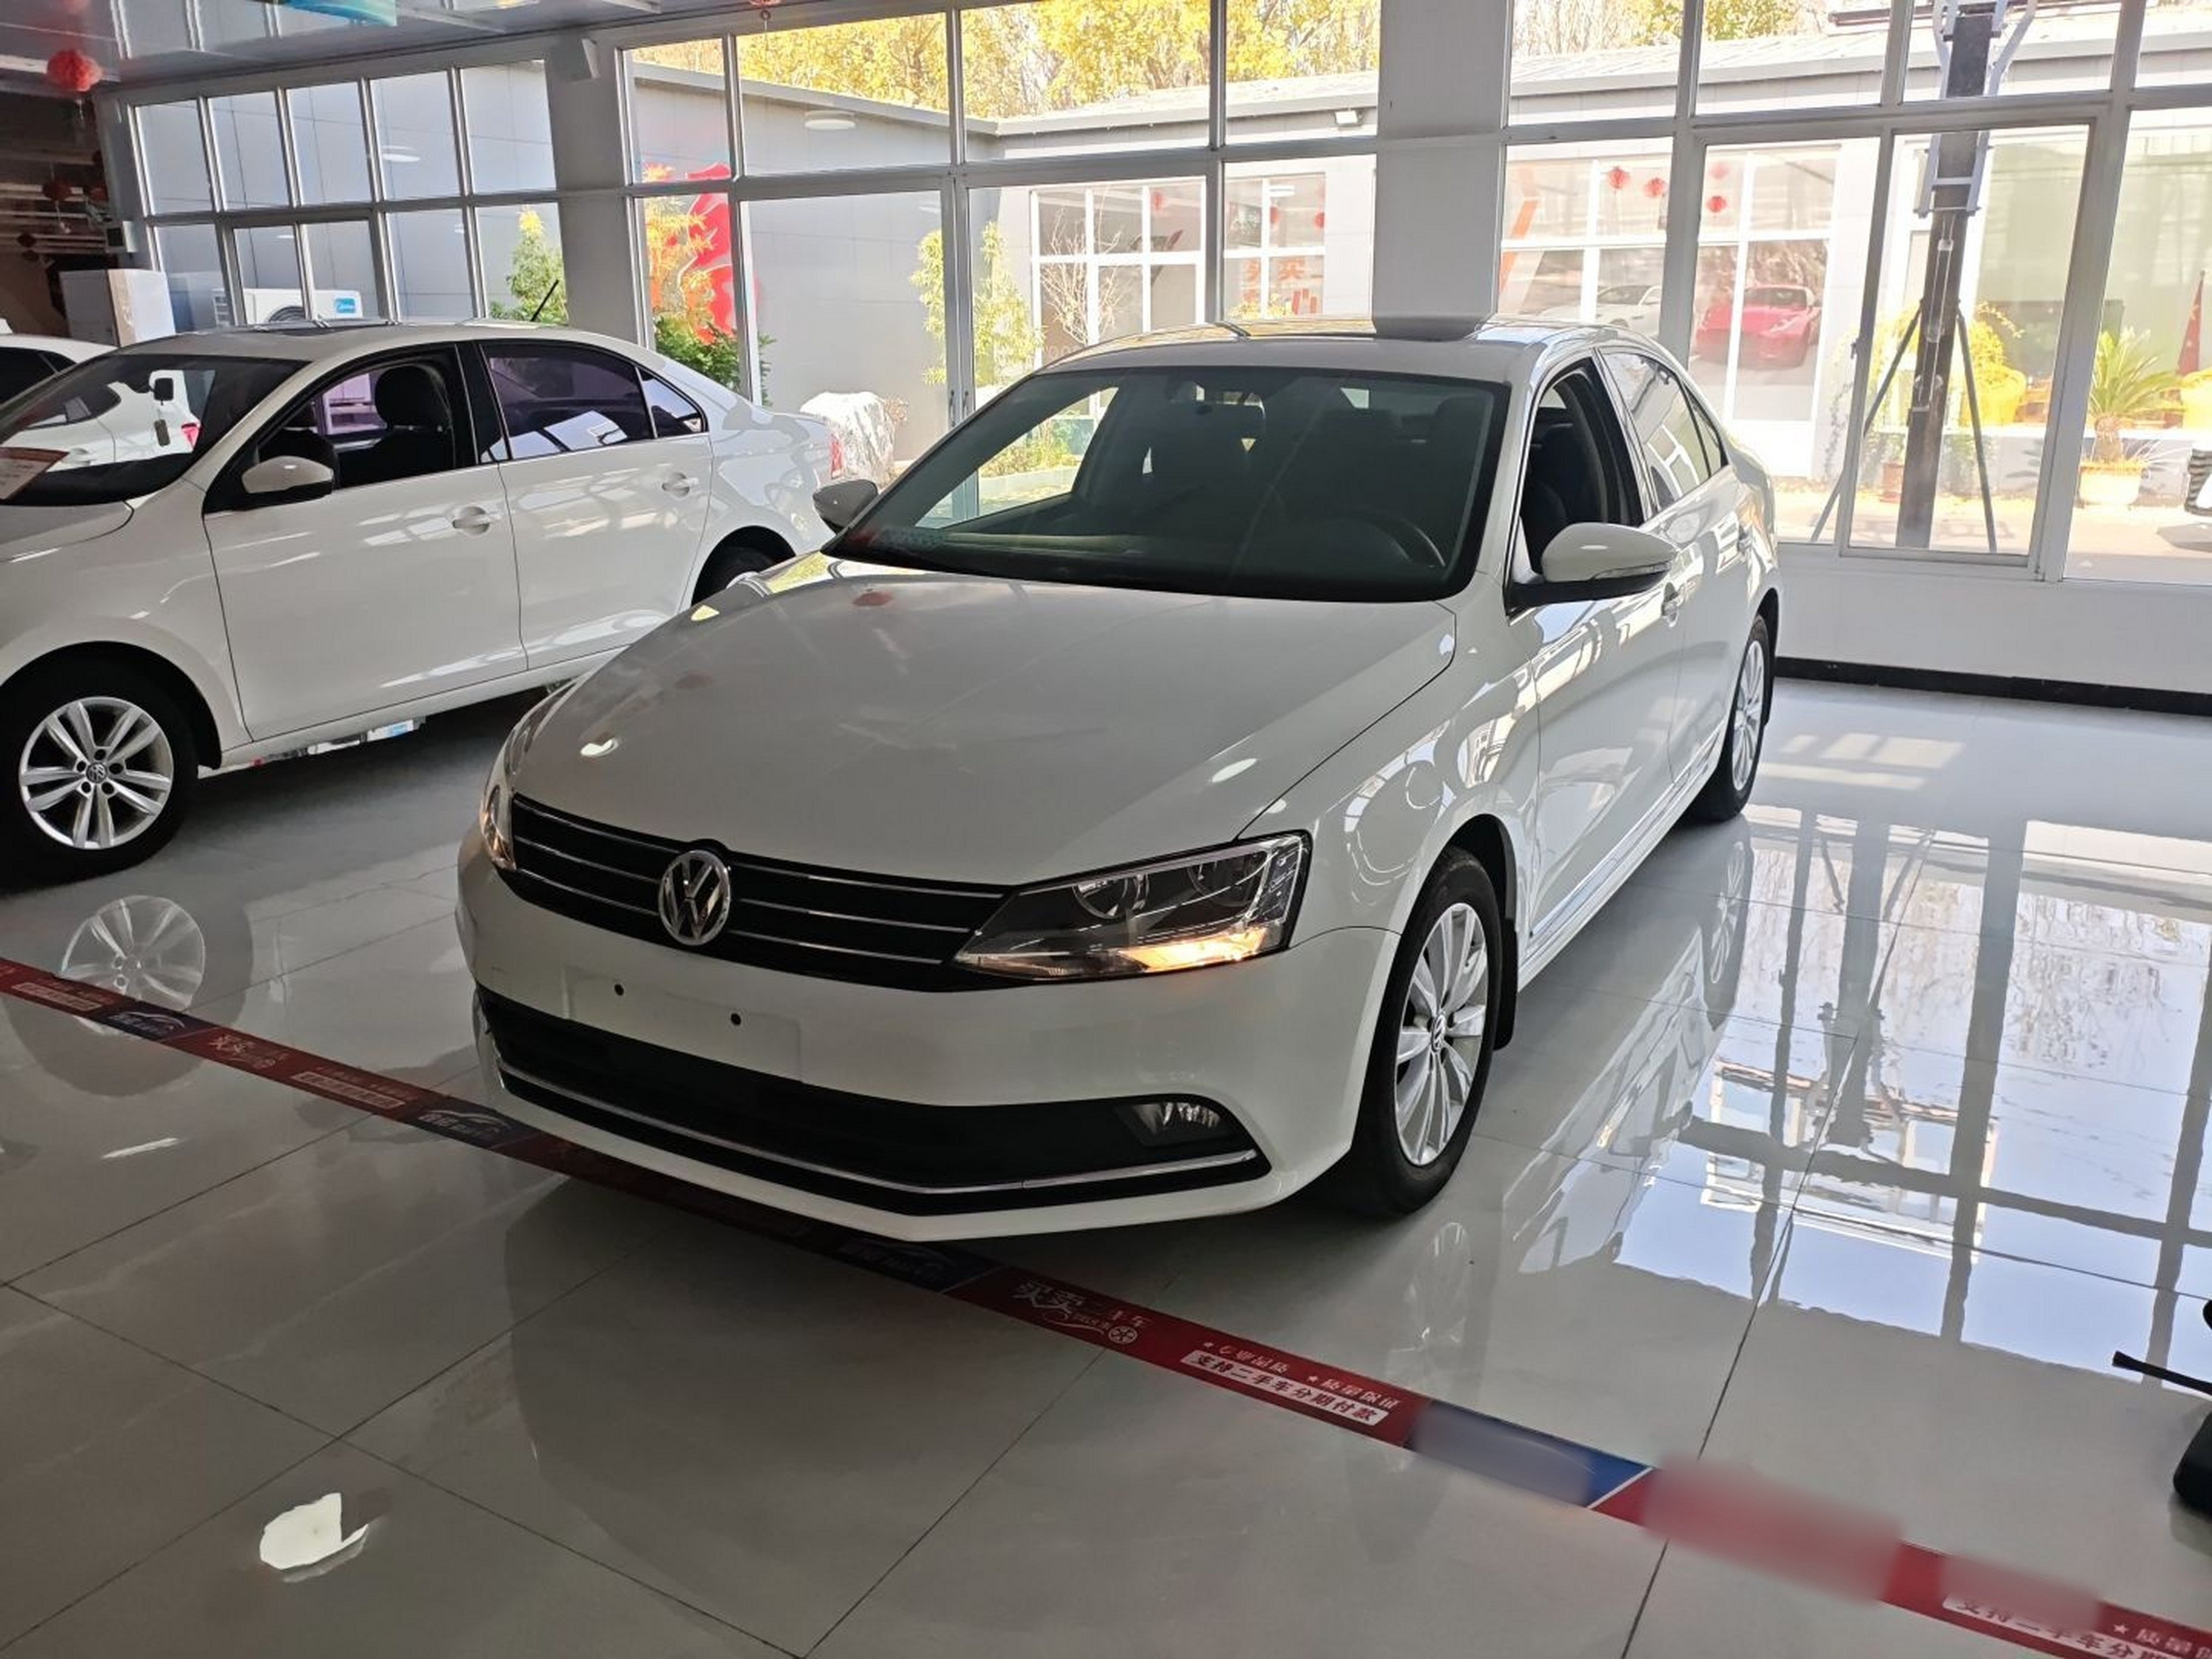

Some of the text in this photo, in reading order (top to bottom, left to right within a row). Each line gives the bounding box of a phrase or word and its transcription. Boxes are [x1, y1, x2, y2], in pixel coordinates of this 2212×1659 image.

[660, 850, 730, 945] VW
[1190, 1354, 1377, 1421] 支持二手车分期付款
